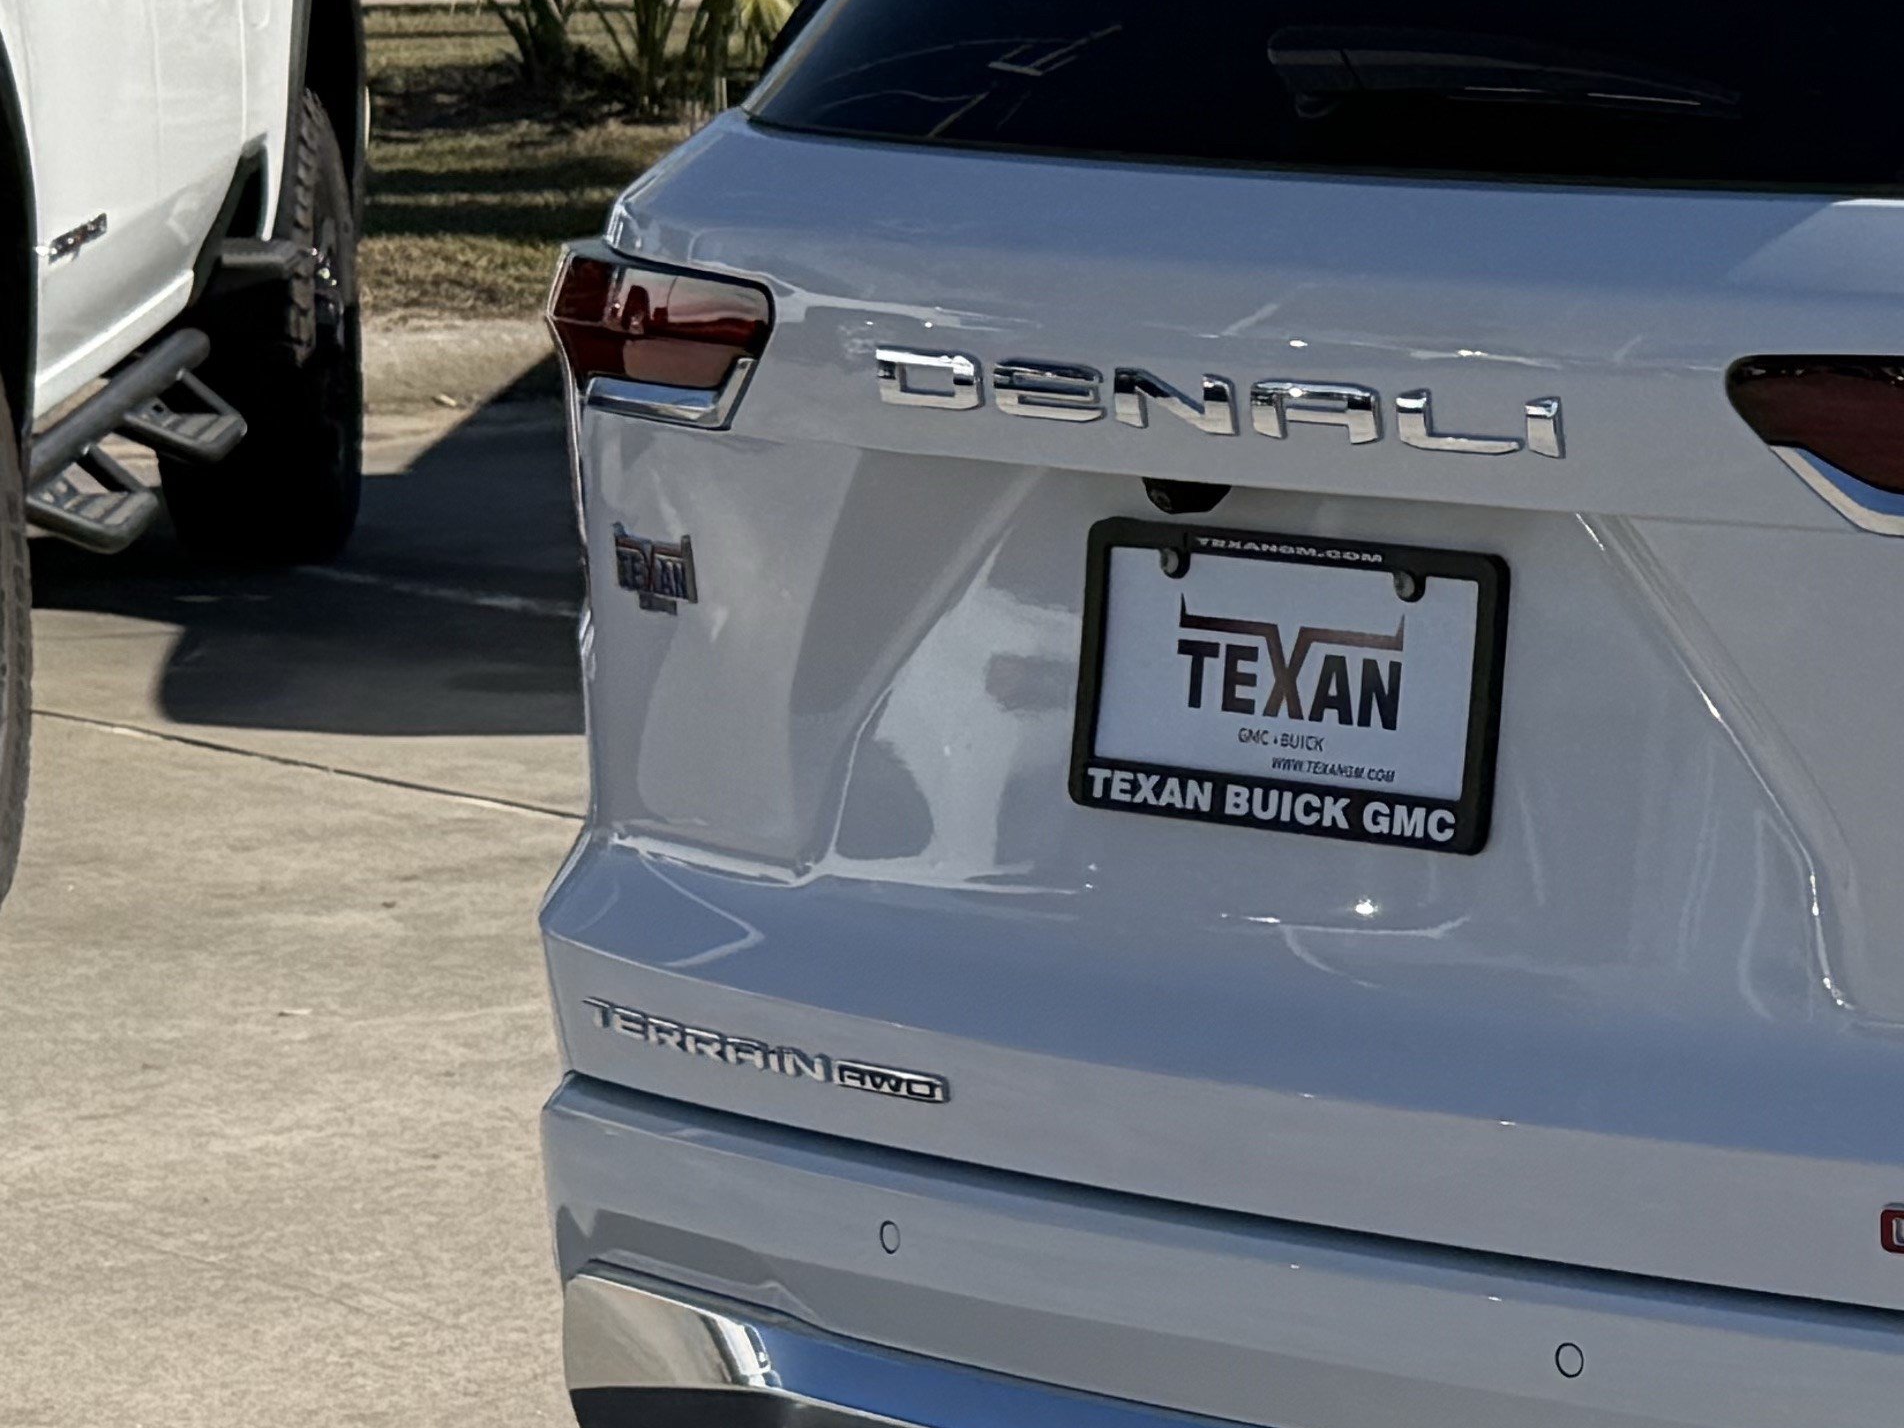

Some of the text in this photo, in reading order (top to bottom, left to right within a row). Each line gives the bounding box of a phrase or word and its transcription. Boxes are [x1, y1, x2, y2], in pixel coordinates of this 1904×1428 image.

[874, 345, 1566, 460] DENALI
[1196, 535, 1383, 563] TEXANGM.COM
[1177, 624, 1404, 731] TEXAN
[1238, 727, 1326, 753] GMC BUICK
[1087, 767, 1457, 843] TEXAN BUICK GMC
[582, 995, 832, 1083] TERRAIN
